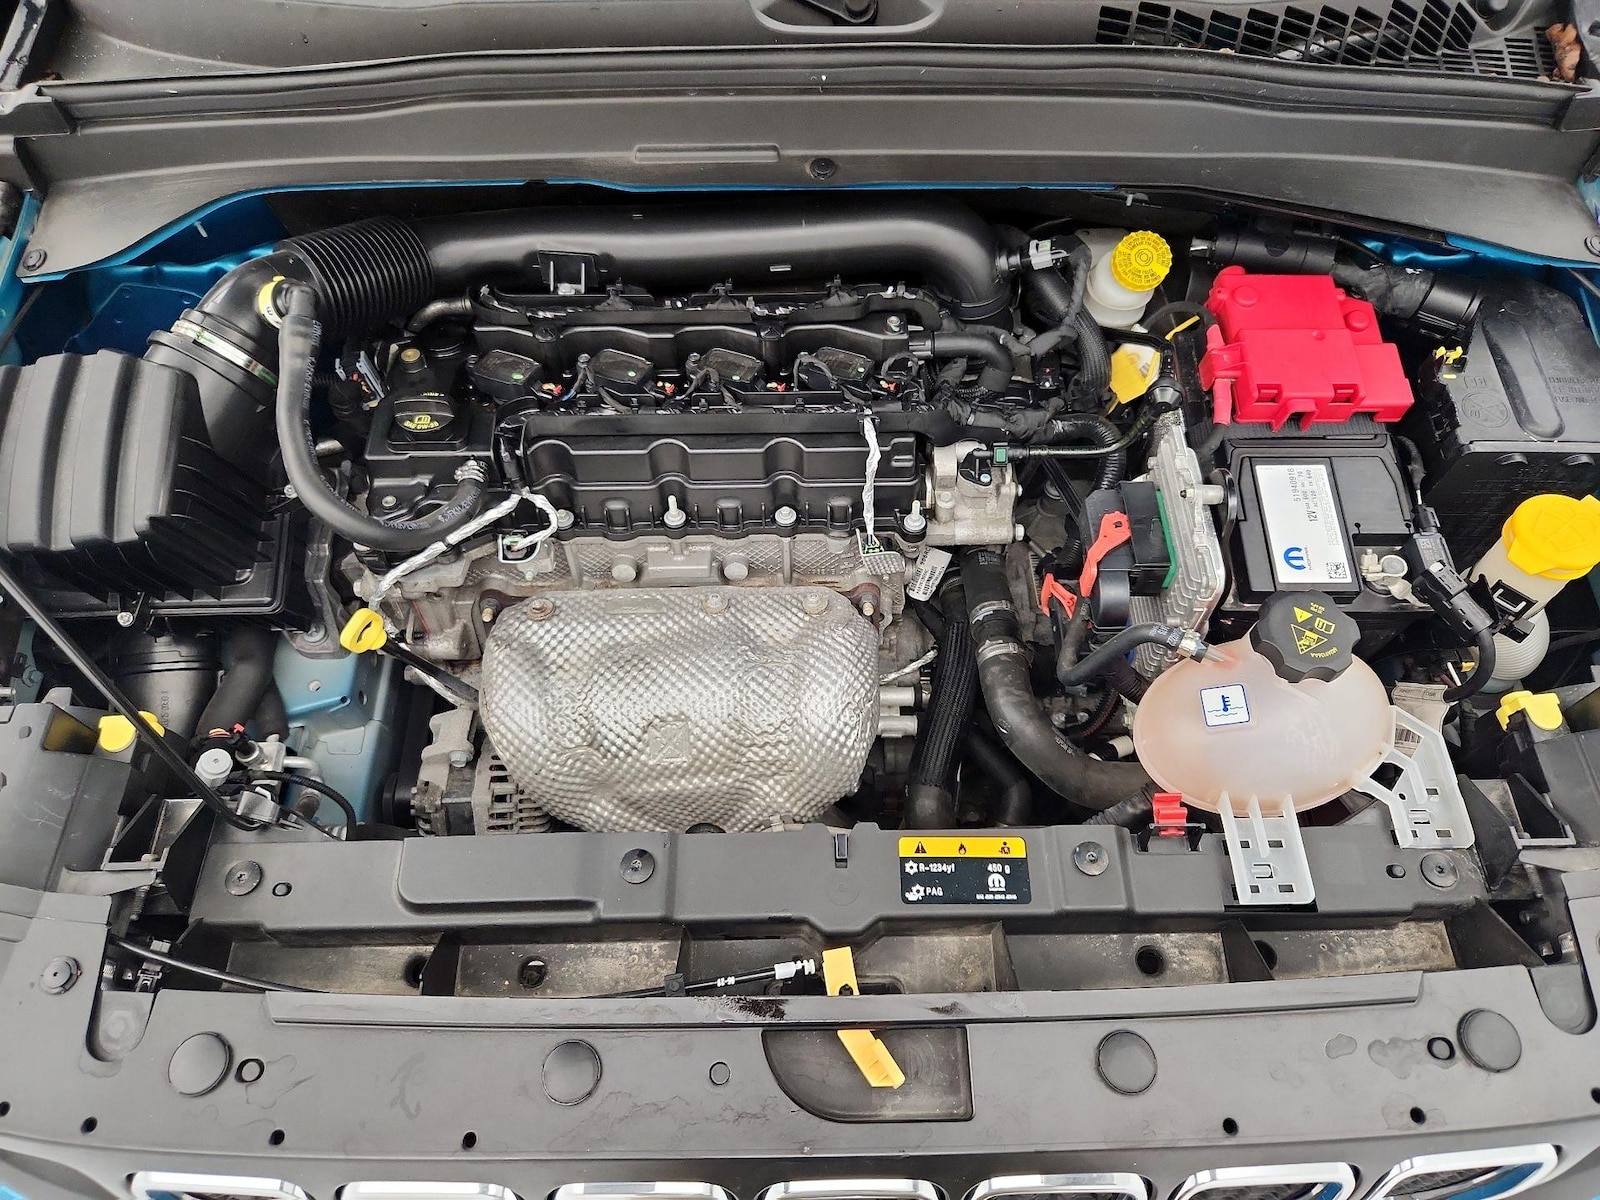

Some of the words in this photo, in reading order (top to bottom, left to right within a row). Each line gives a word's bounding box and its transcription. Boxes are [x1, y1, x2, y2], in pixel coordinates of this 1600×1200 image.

[1287, 467, 1301, 502] 51940918
[1306, 510, 1318, 522] 12V
[987, 862, 1003, 873] 450
[1004, 864, 1011, 875] g
[926, 886, 944, 897] PAG
